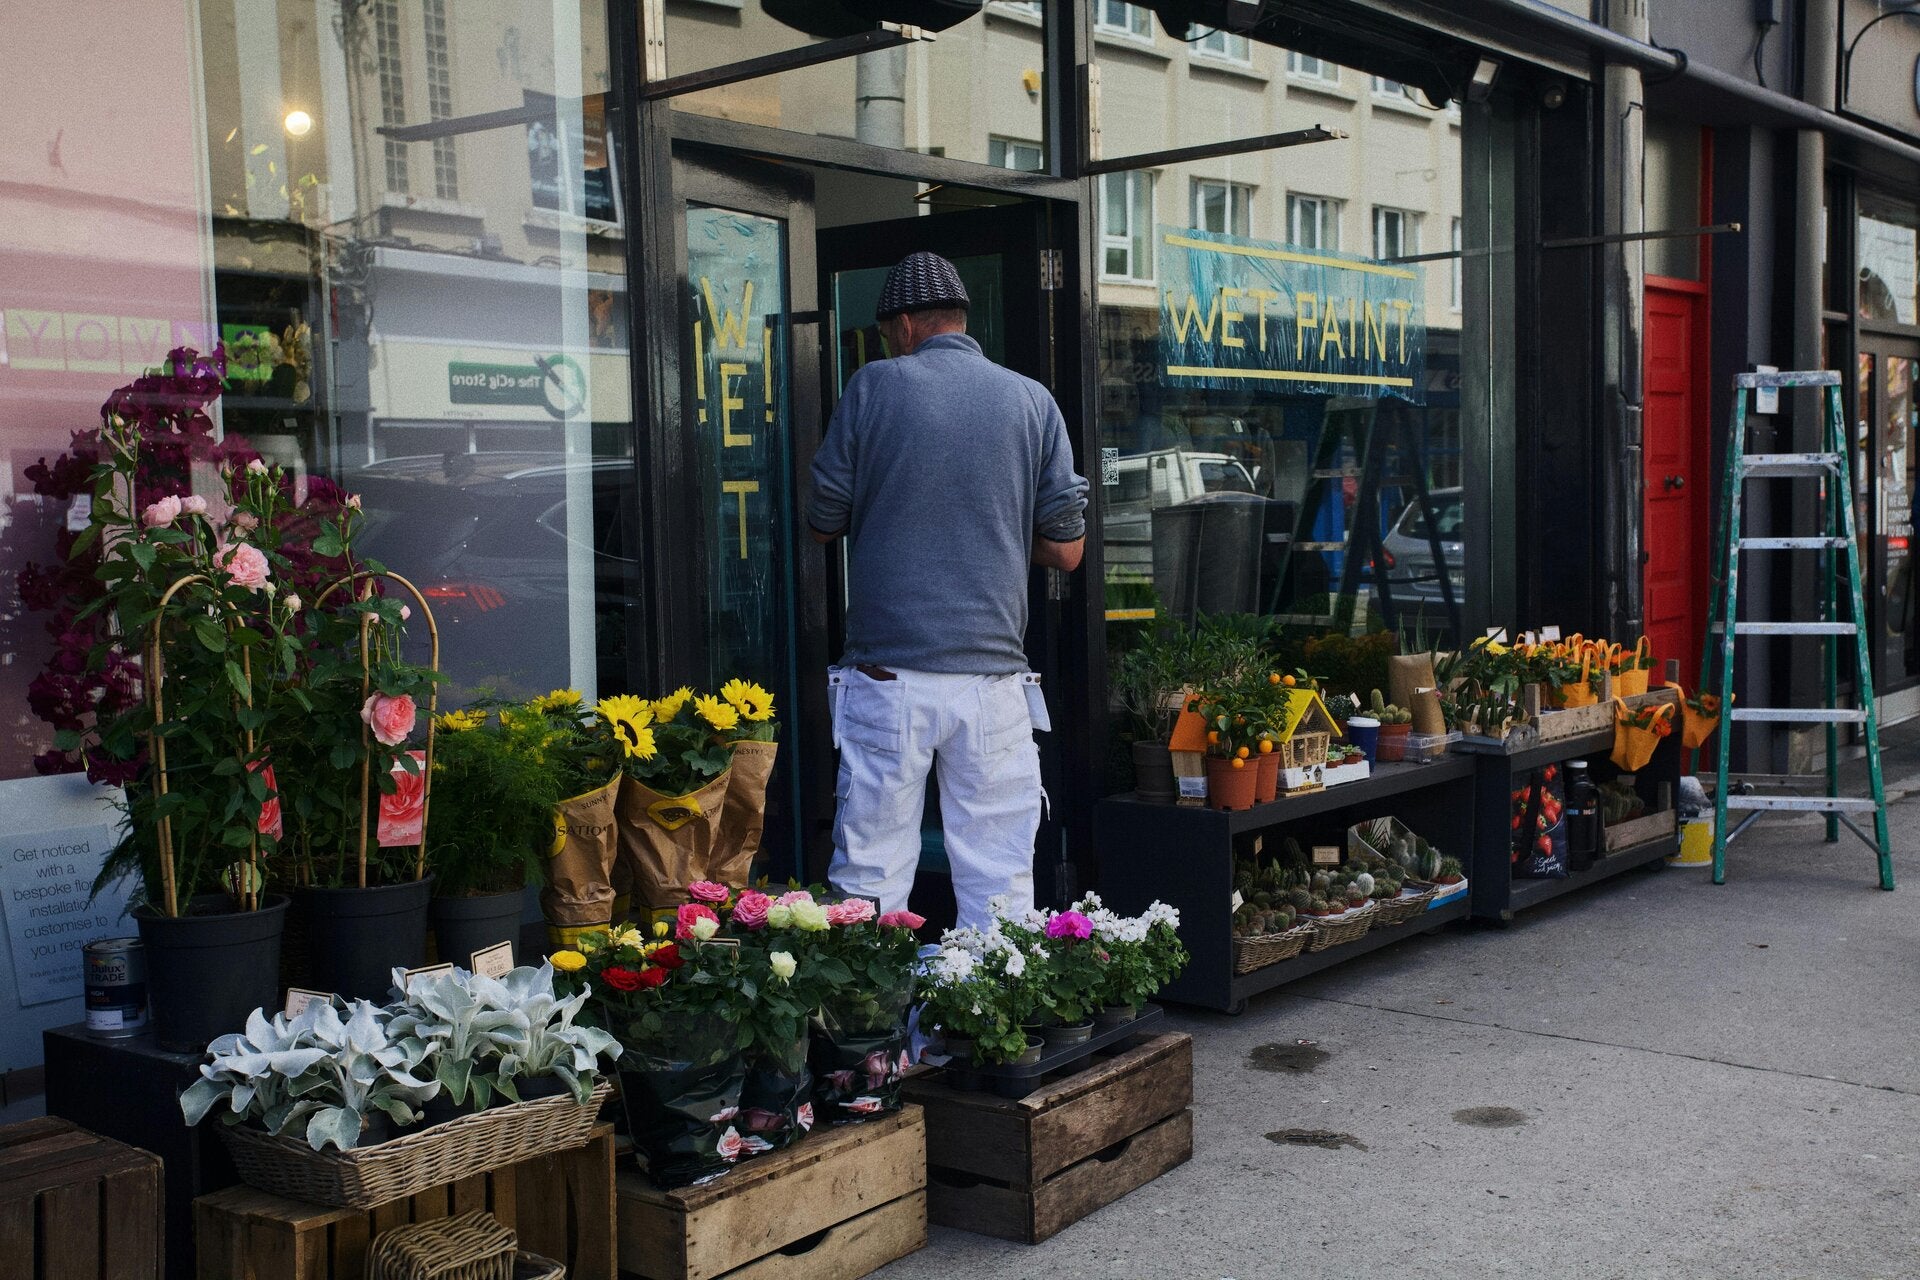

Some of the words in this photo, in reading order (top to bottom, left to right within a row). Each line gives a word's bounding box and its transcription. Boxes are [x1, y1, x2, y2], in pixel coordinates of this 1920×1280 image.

[1166, 287, 1277, 352] WET
[1296, 291, 1412, 365] PAINT
[13, 847, 39, 863] Get
[42, 841, 91, 859] noticed
[36, 865, 64, 879] with
[67, 864, 75, 874] a
[13, 881, 72, 902] bespoke
[29, 899, 97, 919] installation
[24, 918, 93, 939] customise
[96, 915, 108, 927] to
[30, 944, 56, 960] you
[89, 972, 125, 982] TRADE
[91, 964, 121, 974] Dulux
